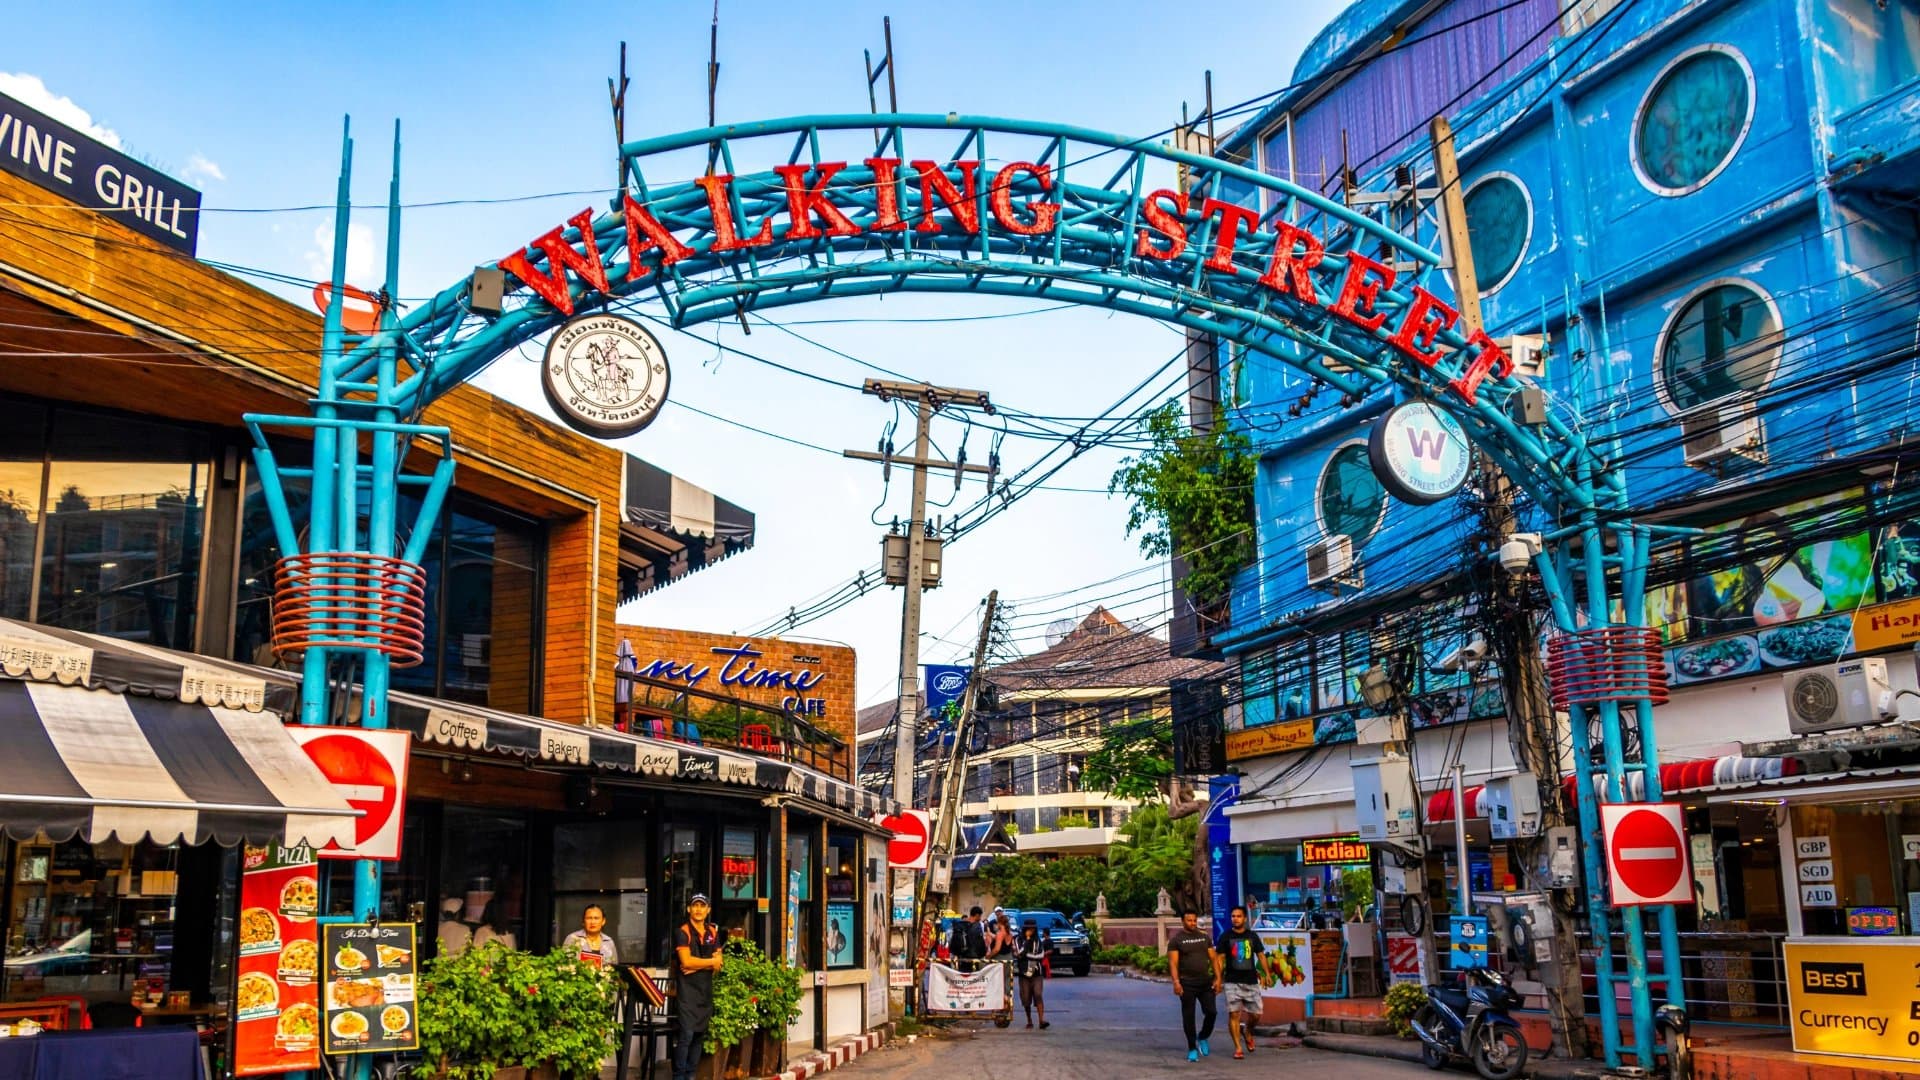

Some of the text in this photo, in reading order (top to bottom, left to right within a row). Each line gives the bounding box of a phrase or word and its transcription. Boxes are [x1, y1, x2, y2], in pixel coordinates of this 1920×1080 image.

[94, 163, 188, 240] GRILL
[498, 157, 1516, 406] WALKING STREET
[559, 319, 652, 350] เมืองพัทยา
[782, 695, 826, 716] CAFE
[439, 719, 478, 741] Coffee
[547, 738, 582, 760] Bakery
[642, 753, 673, 770] any
[682, 757, 713, 772] time
[728, 763, 748, 778] Wine
[277, 846, 311, 864] PIZZA
[1305, 841, 1368, 863] Indian
[1800, 841, 1827, 854] GBP
[1802, 865, 1830, 878] SGD
[1806, 889, 1833, 902] AUD
[1849, 915, 1897, 928] OPEN
[1805, 970, 1863, 989] BEST
[1799, 1009, 1889, 1036] Currency
